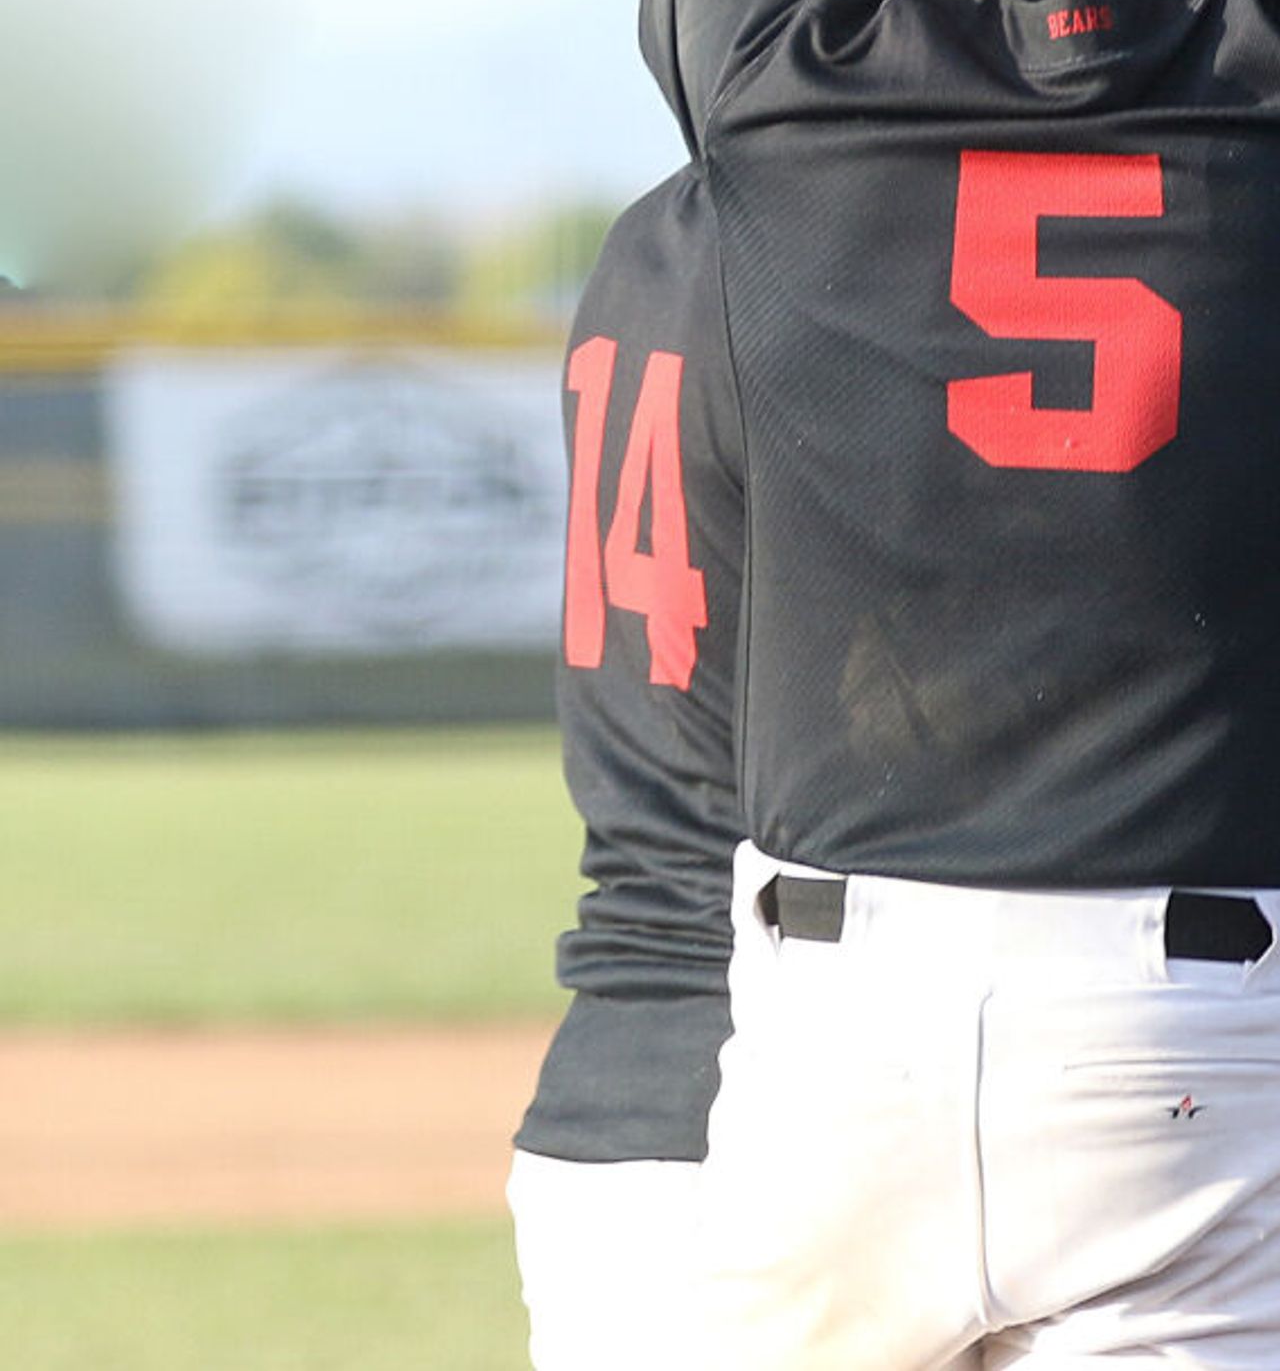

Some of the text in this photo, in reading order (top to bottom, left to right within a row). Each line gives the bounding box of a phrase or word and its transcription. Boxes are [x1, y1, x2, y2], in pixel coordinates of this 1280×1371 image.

[1046, 4, 1114, 40] BEARS
[947, 149, 1182, 472] 5
[563, 336, 708, 691] 14
